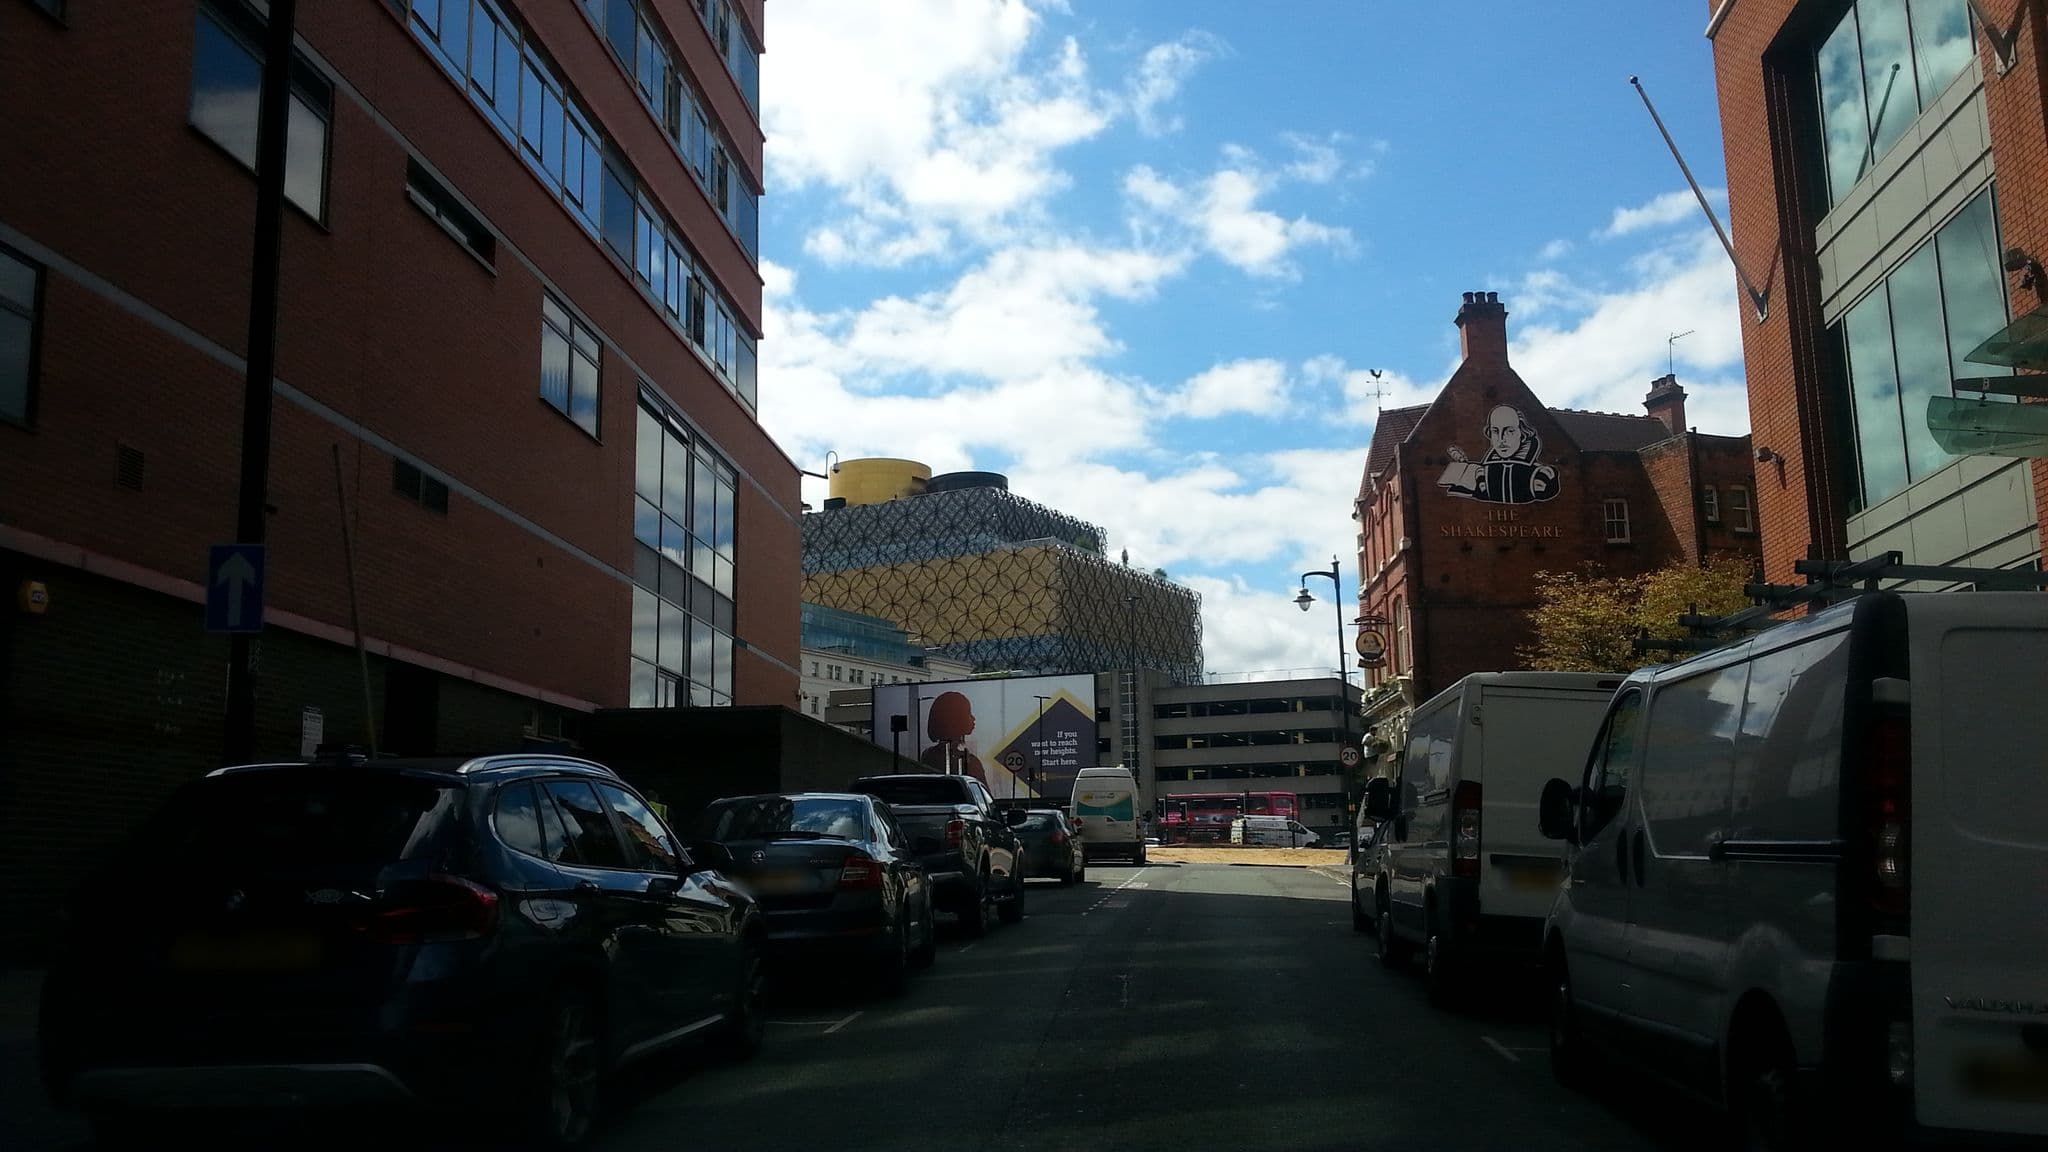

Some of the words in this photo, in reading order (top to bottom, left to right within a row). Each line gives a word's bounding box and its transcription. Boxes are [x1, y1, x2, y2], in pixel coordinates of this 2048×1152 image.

[1488, 510, 1519, 521] THE
[1441, 525, 1562, 537] SHAKESPEARE
[1343, 751, 1357, 761] 20
[1007, 757, 1023, 766] 20
[1042, 758, 1060, 766] Start
